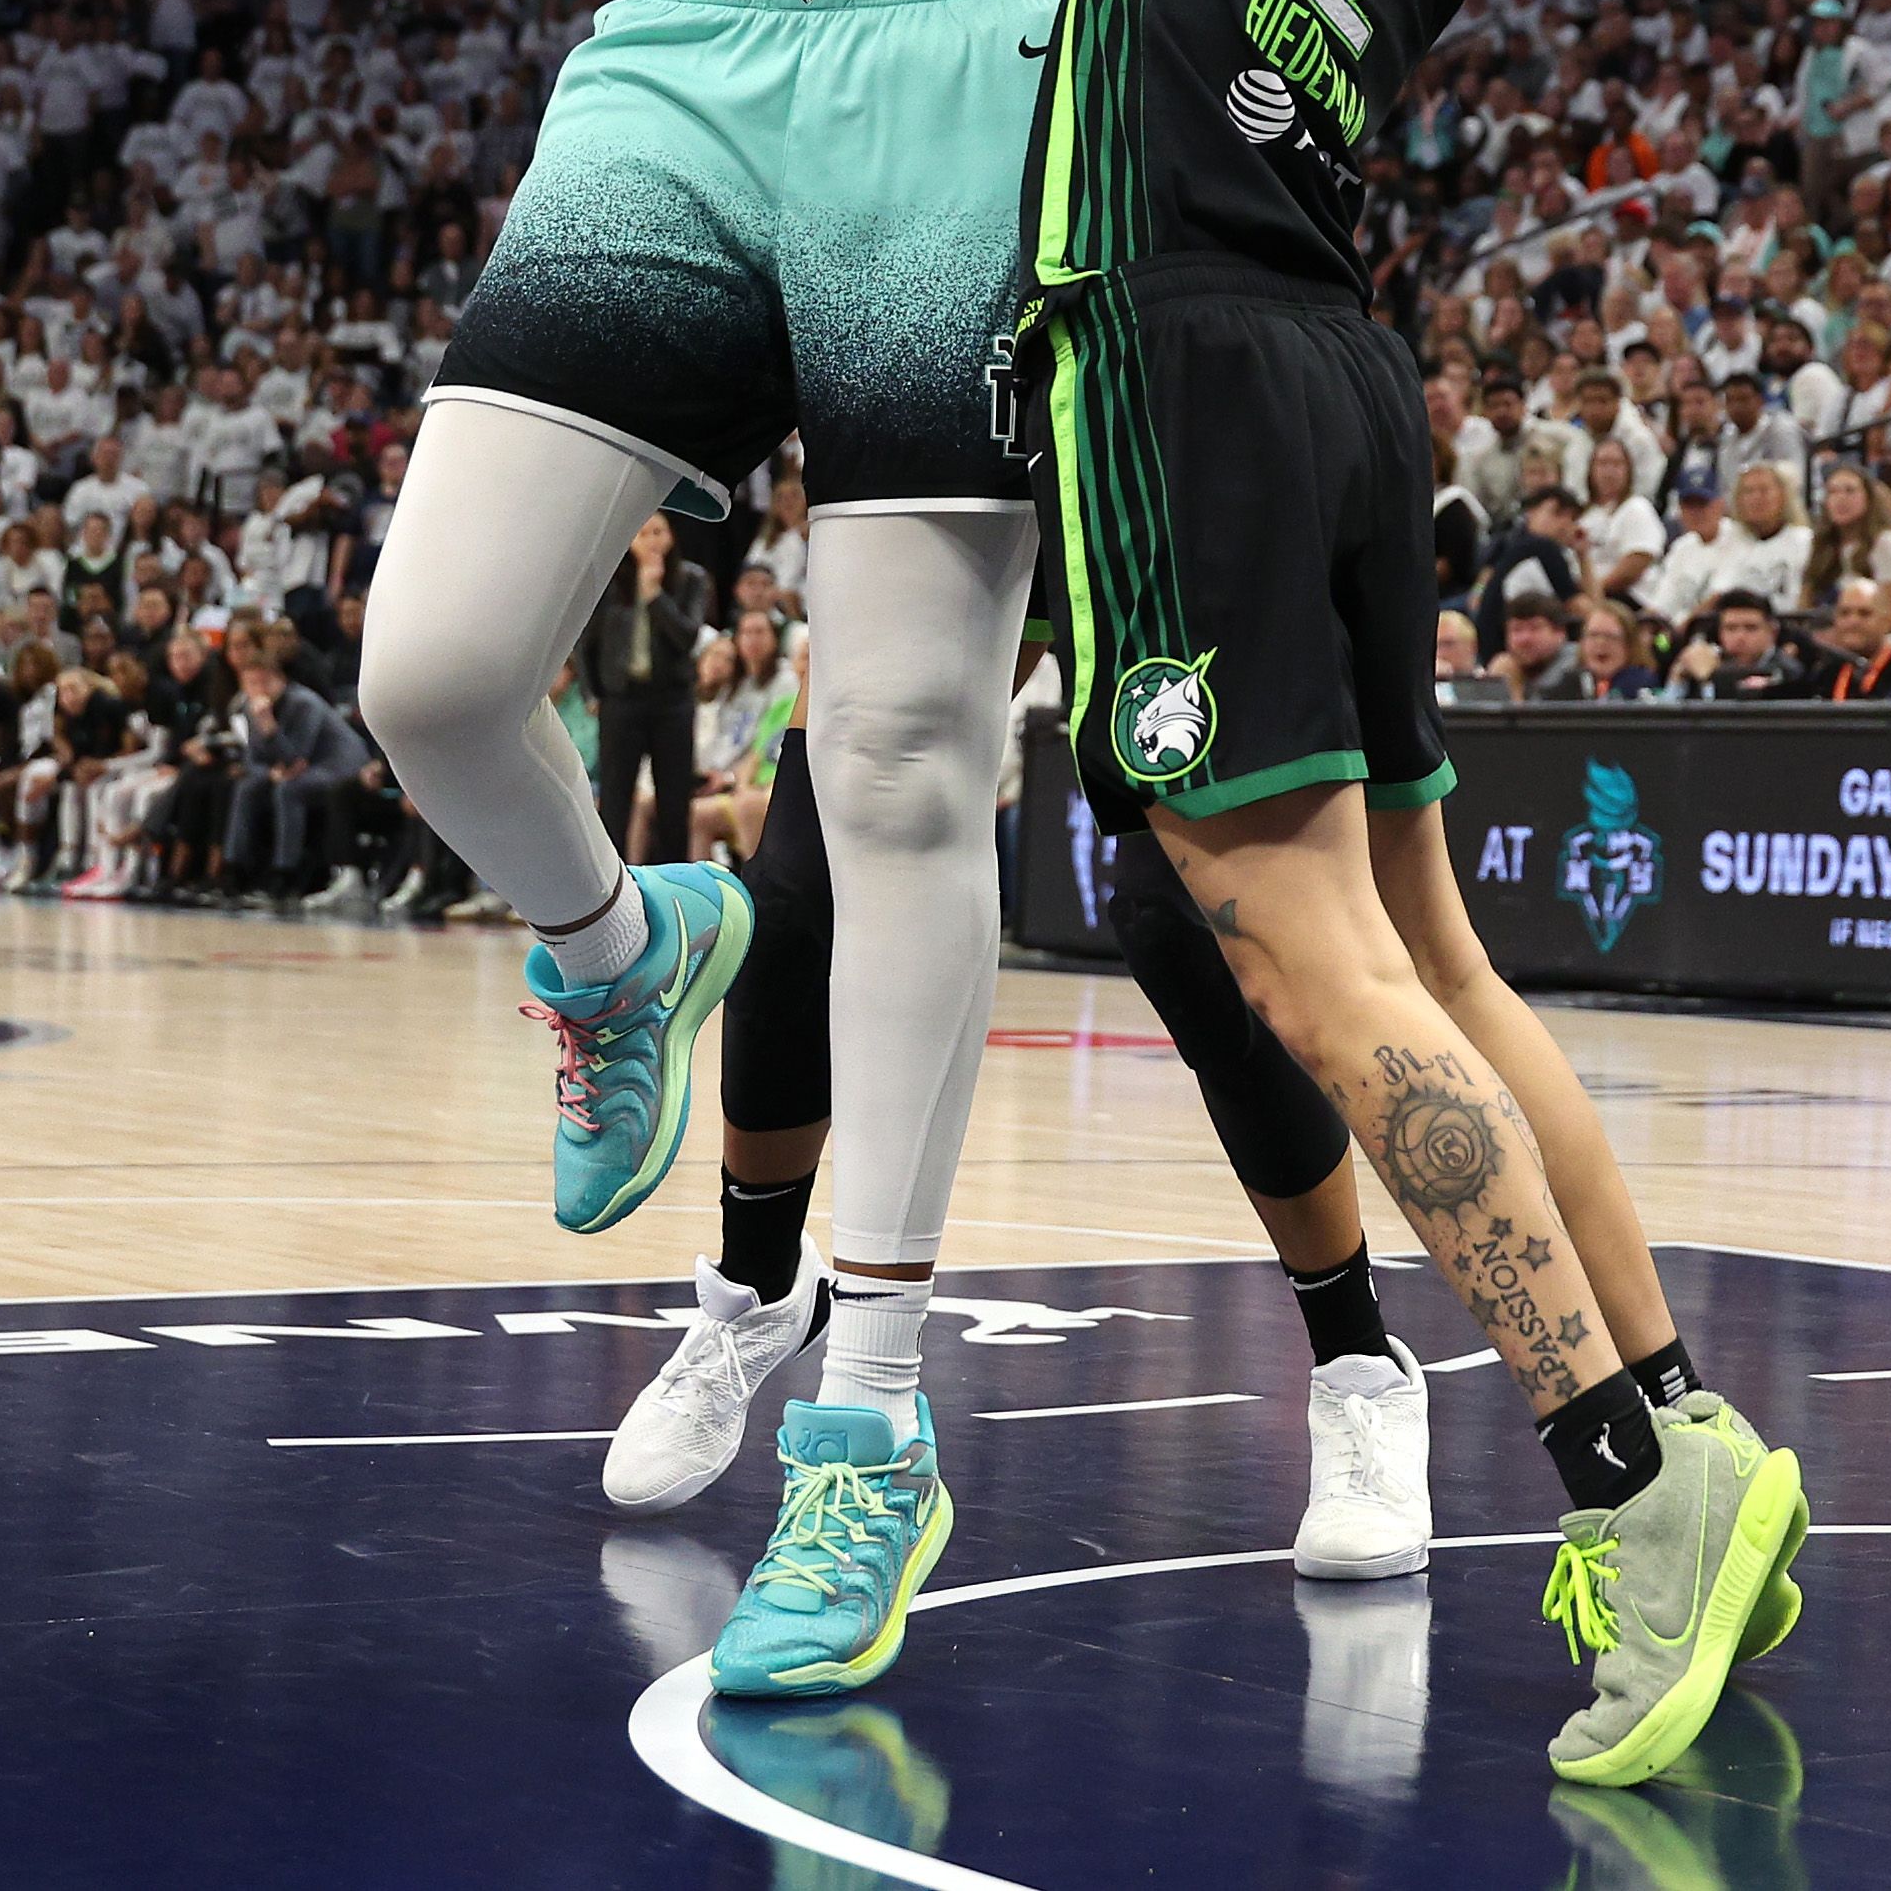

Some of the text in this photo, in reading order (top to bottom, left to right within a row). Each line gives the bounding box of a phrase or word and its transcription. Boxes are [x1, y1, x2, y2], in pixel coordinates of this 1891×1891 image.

[1478, 826, 1534, 884] AT
[1829, 917, 1853, 947] IF
[1472, 1237, 1570, 1391] PASSION
